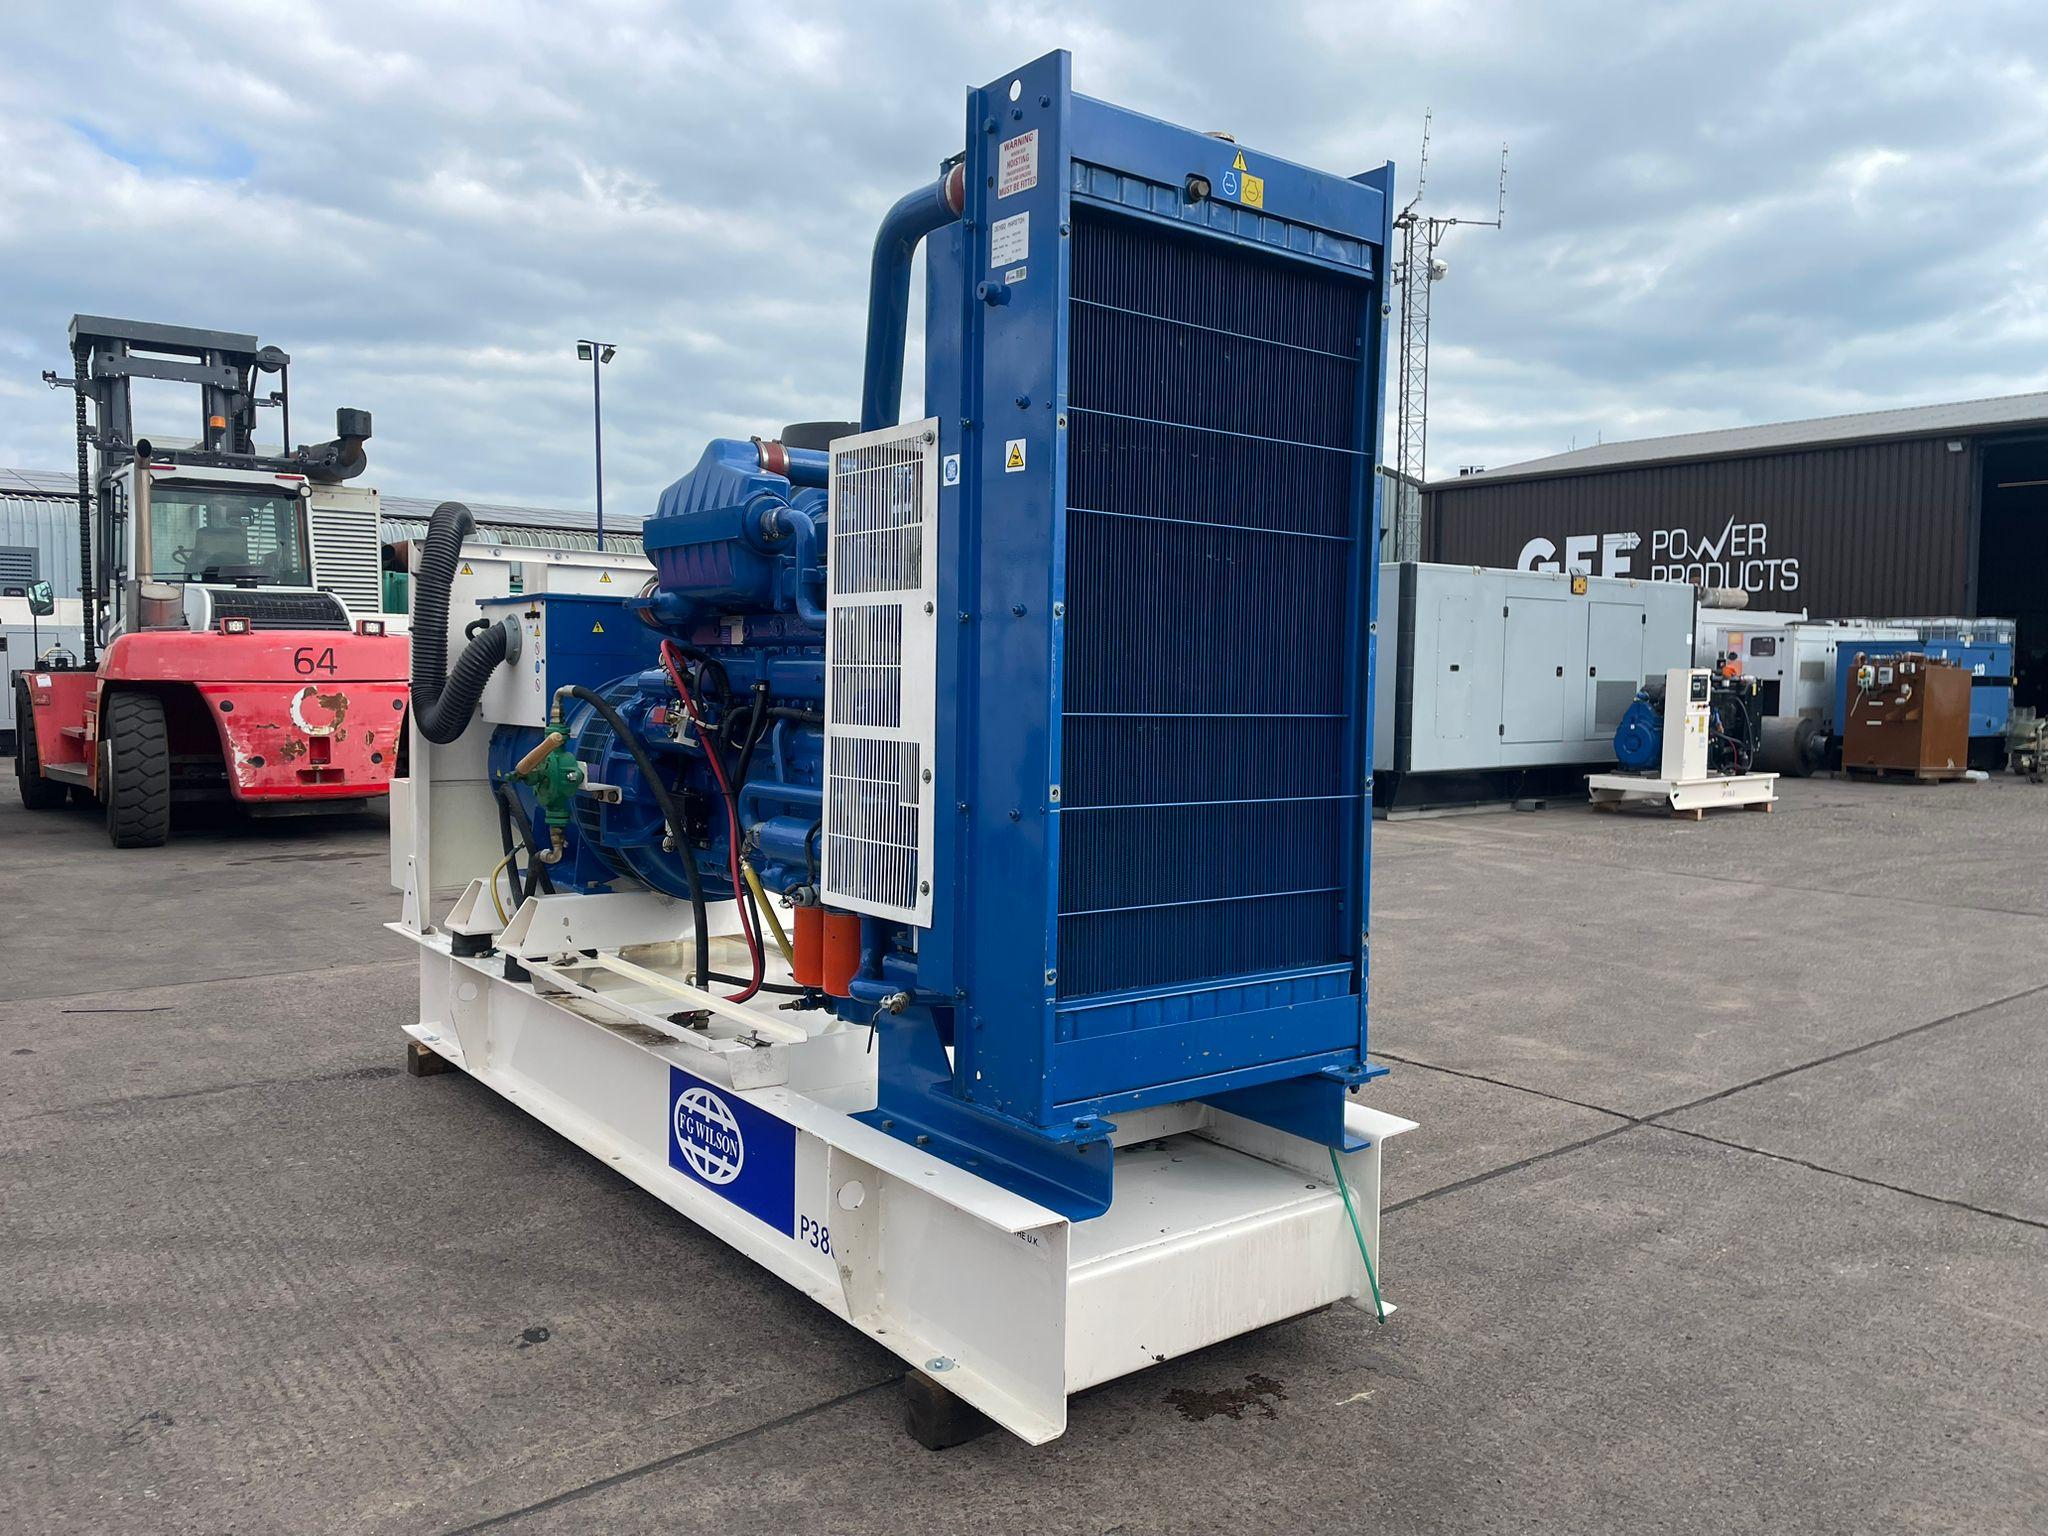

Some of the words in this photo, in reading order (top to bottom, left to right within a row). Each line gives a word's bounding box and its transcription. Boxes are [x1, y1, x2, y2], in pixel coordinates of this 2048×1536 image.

[1004, 133, 1034, 151] WARNING
[1007, 154, 1030, 168] HOISTING
[1652, 514, 1766, 561] POWER
[294, 647, 338, 676] 64
[696, 1122, 738, 1158] WILSON
[801, 1214, 836, 1260] P38
[1013, 1231, 1026, 1241] HE
